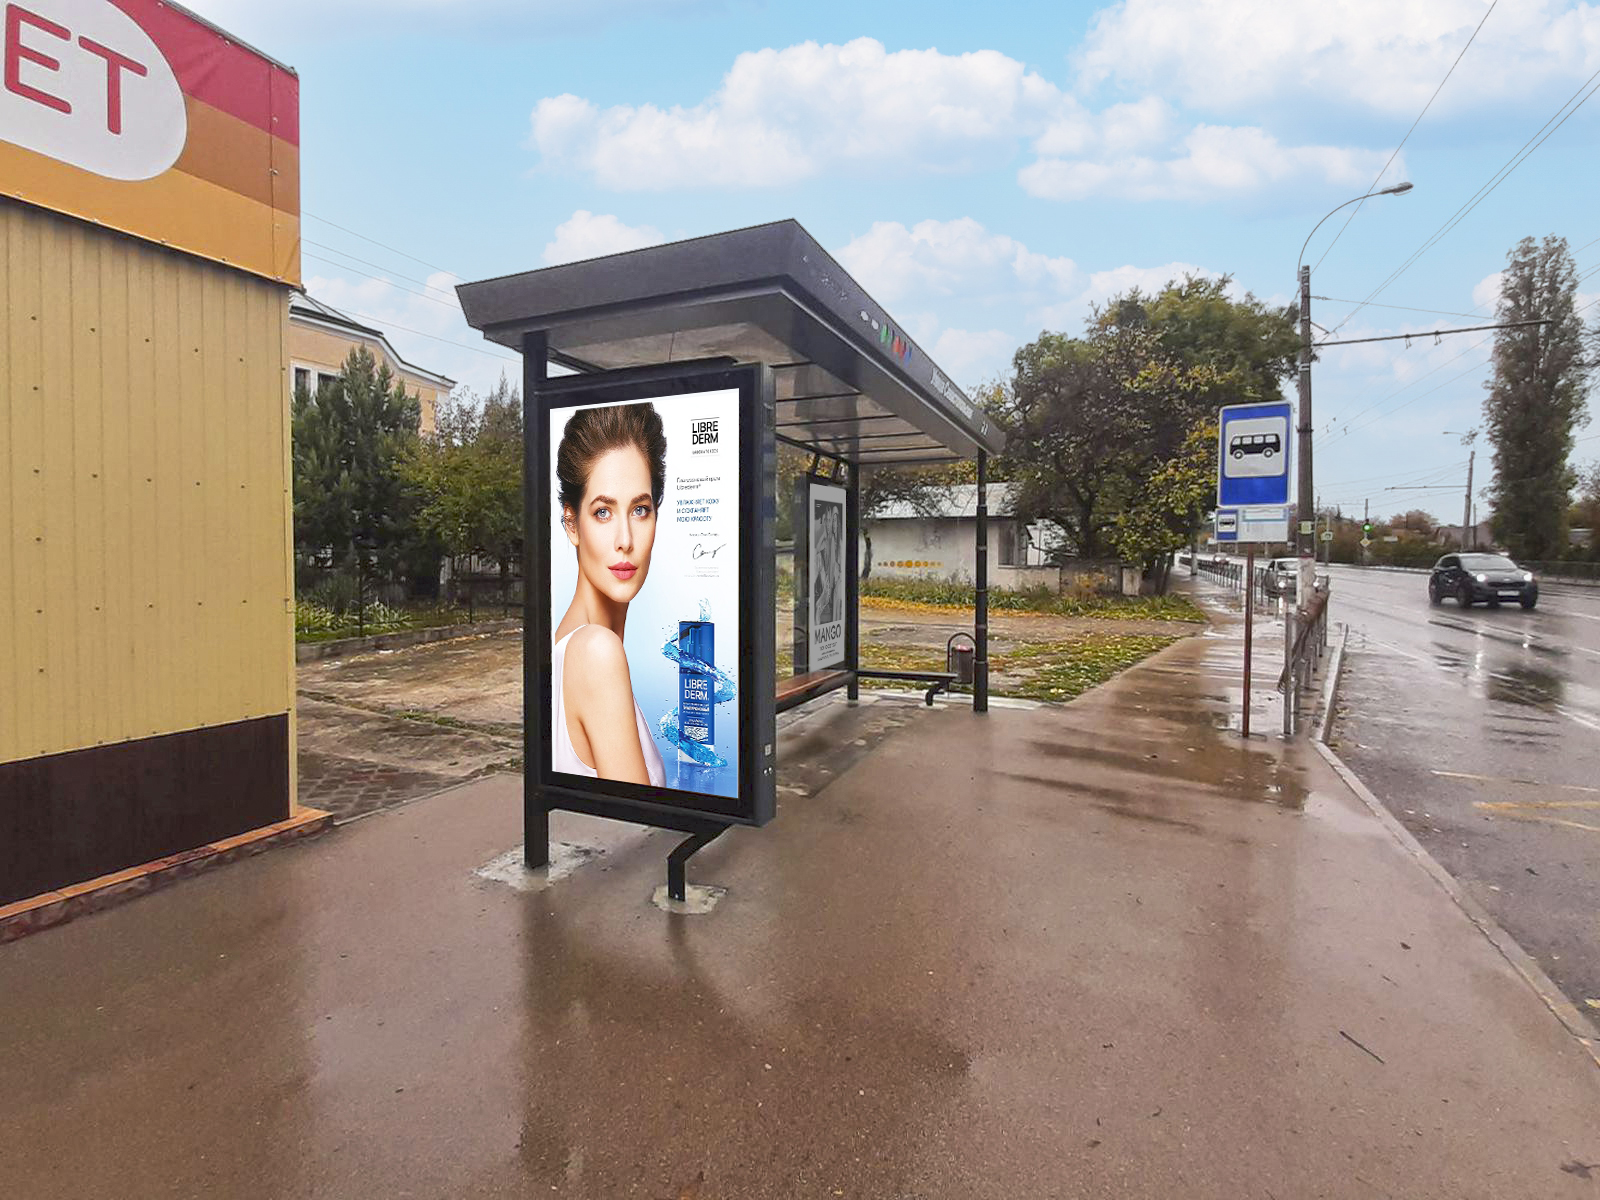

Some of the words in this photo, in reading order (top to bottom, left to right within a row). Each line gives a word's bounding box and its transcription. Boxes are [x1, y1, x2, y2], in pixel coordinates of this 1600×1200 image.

[692, 421, 719, 434] LIBRE
[692, 432, 719, 445] DERM
[814, 624, 842, 645] MANGO
[684, 679, 708, 690] LIBRE
[684, 689, 708, 701] DERM
